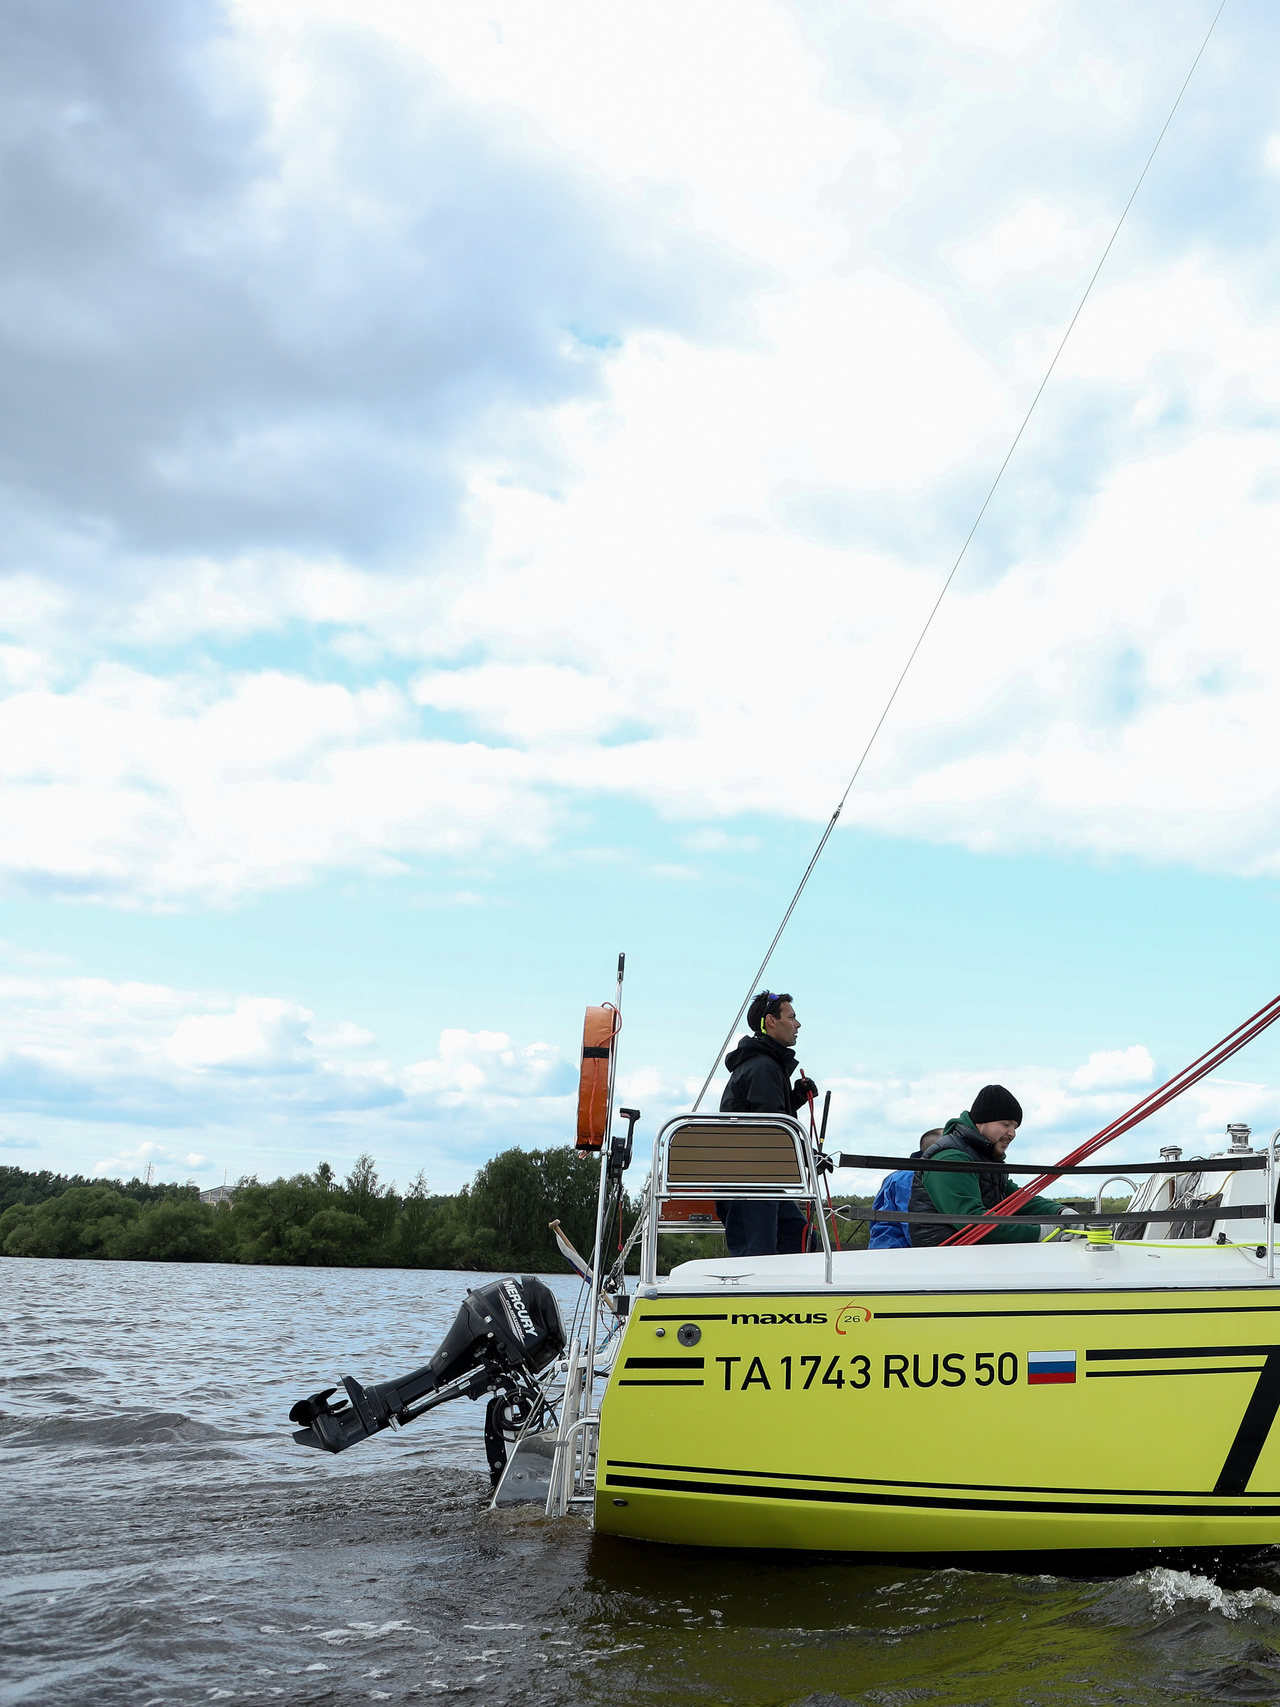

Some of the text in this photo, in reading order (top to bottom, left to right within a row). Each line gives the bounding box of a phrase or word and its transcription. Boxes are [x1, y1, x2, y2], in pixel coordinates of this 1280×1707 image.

[502, 1280, 539, 1337] MERCURY
[731, 1313, 861, 1325] maxus 26
[716, 1352, 1018, 1391] TA 1743 RUS 50
